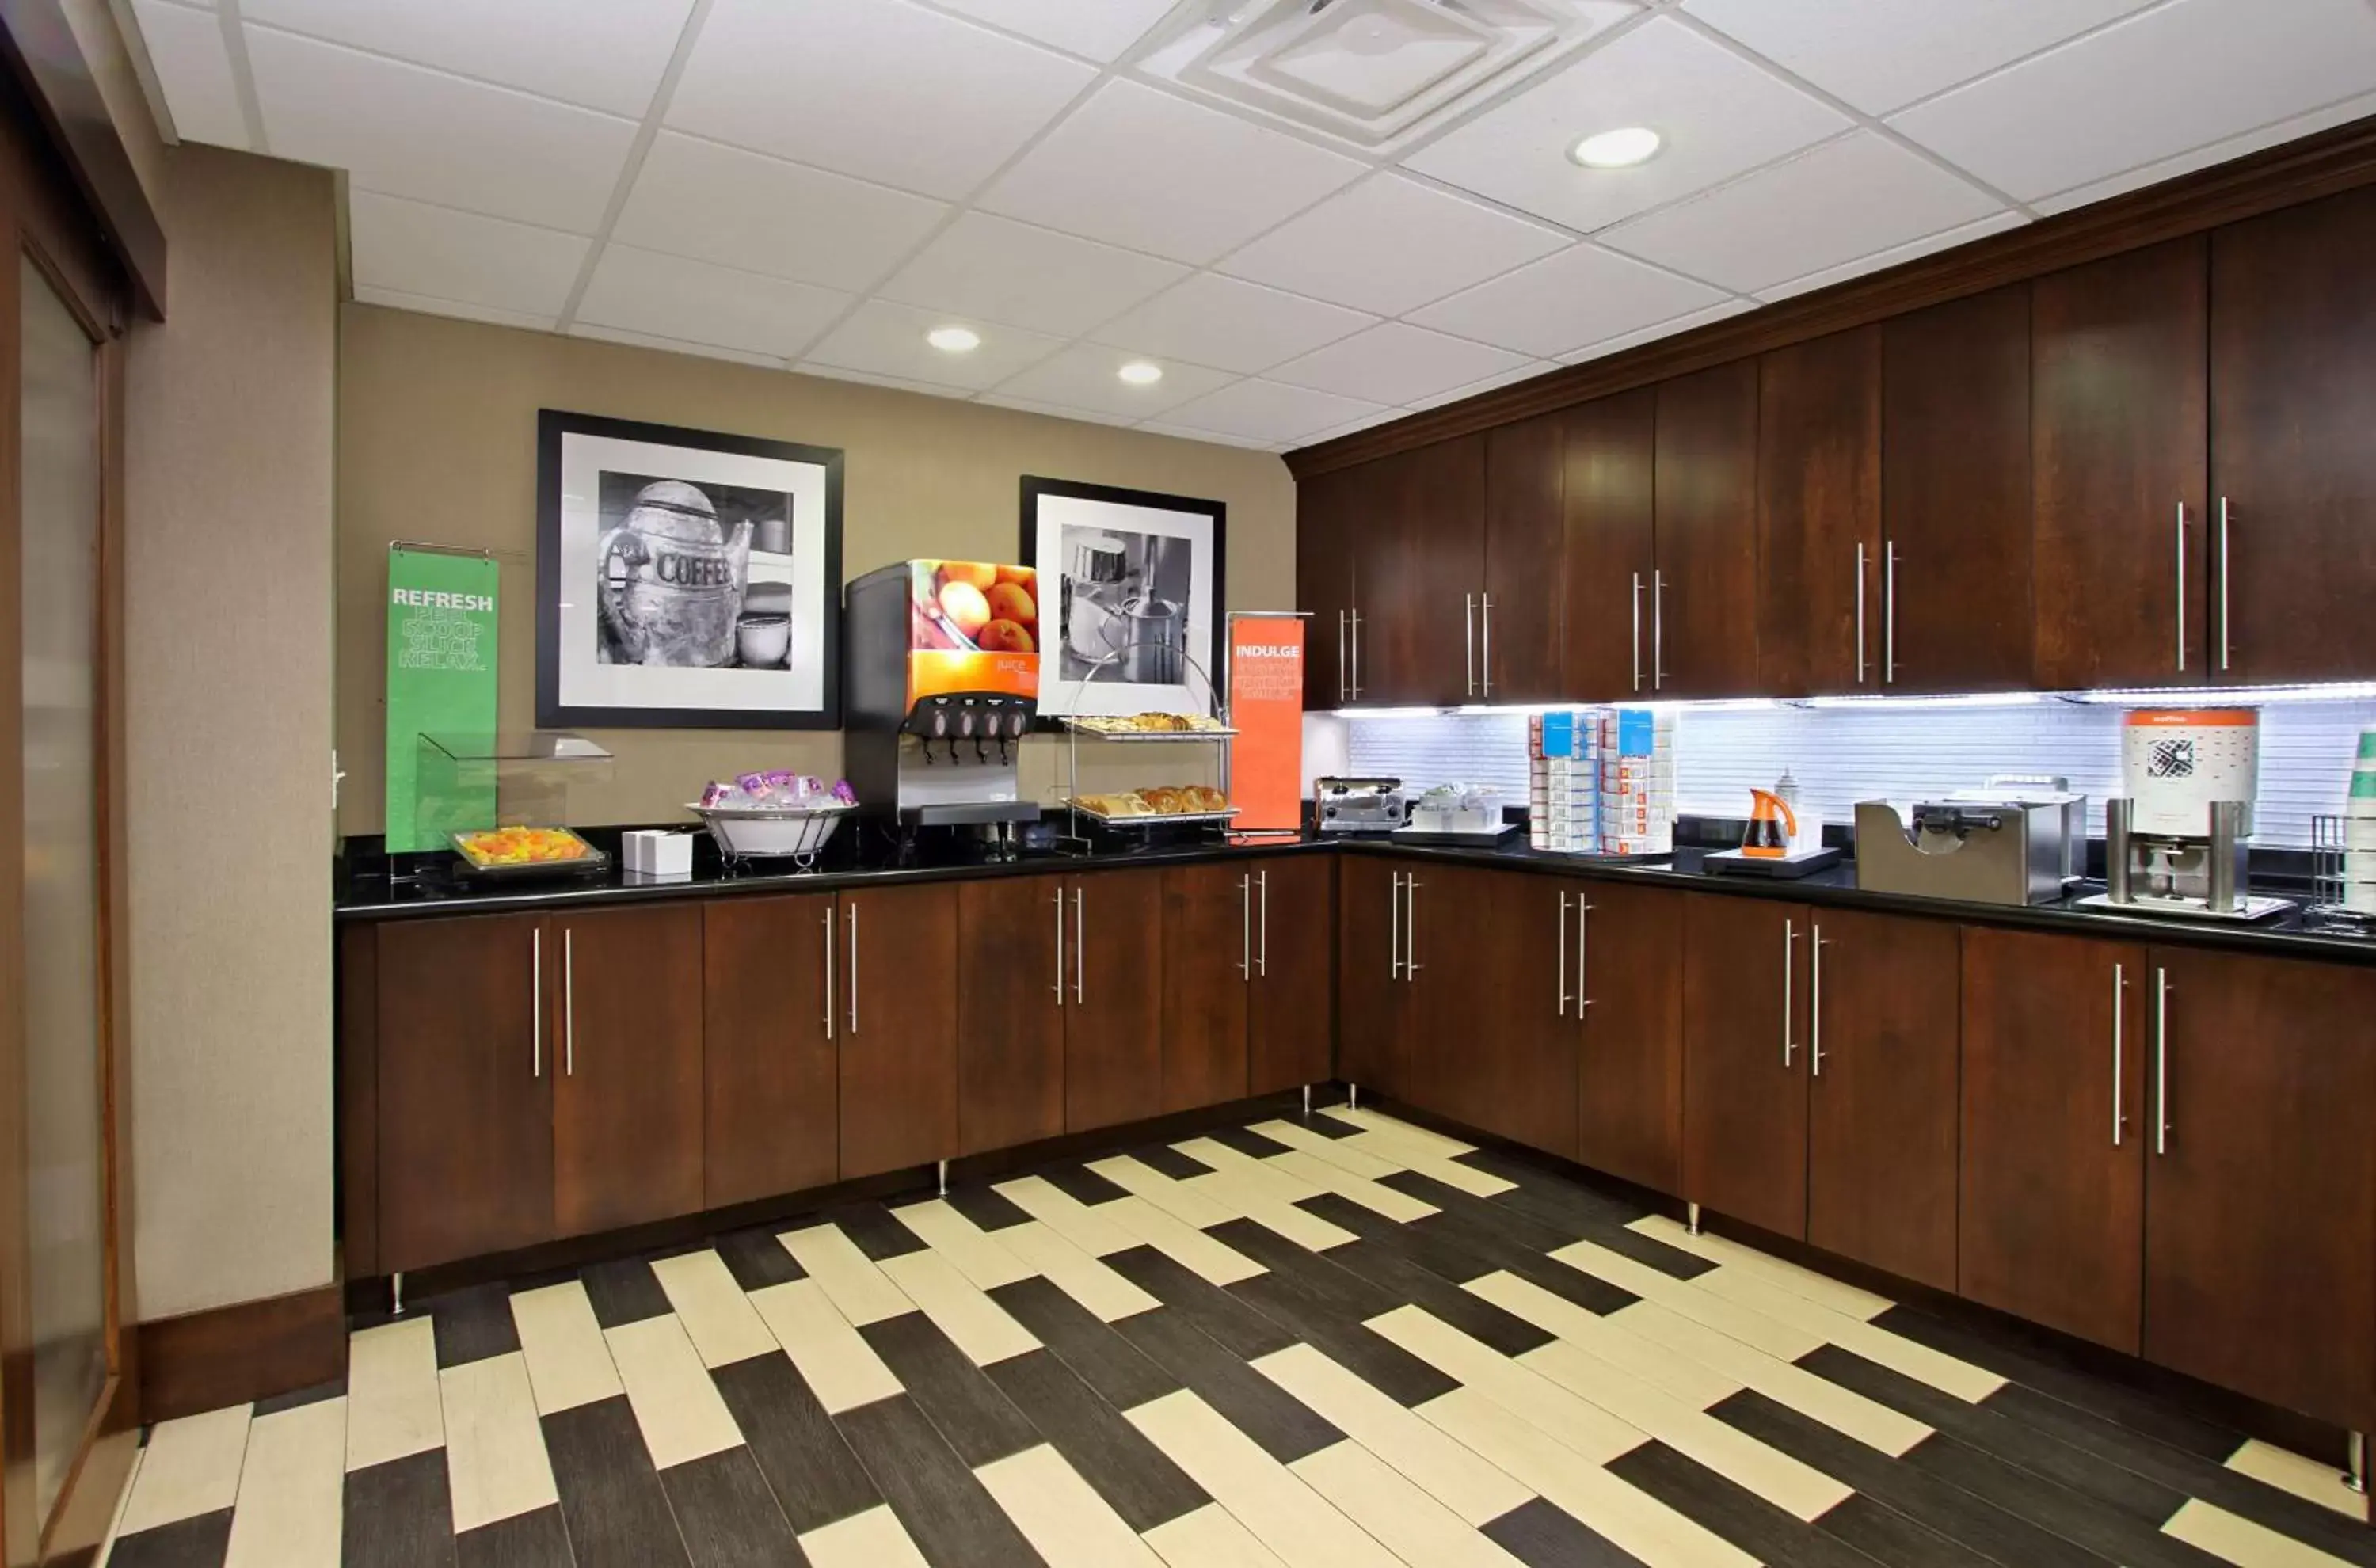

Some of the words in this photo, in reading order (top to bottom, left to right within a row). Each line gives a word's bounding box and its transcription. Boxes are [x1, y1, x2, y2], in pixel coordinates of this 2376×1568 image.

[657, 552, 732, 585] COFFEE
[393, 588, 493, 612] REFRESH
[1236, 645, 1300, 657] INDULGE
